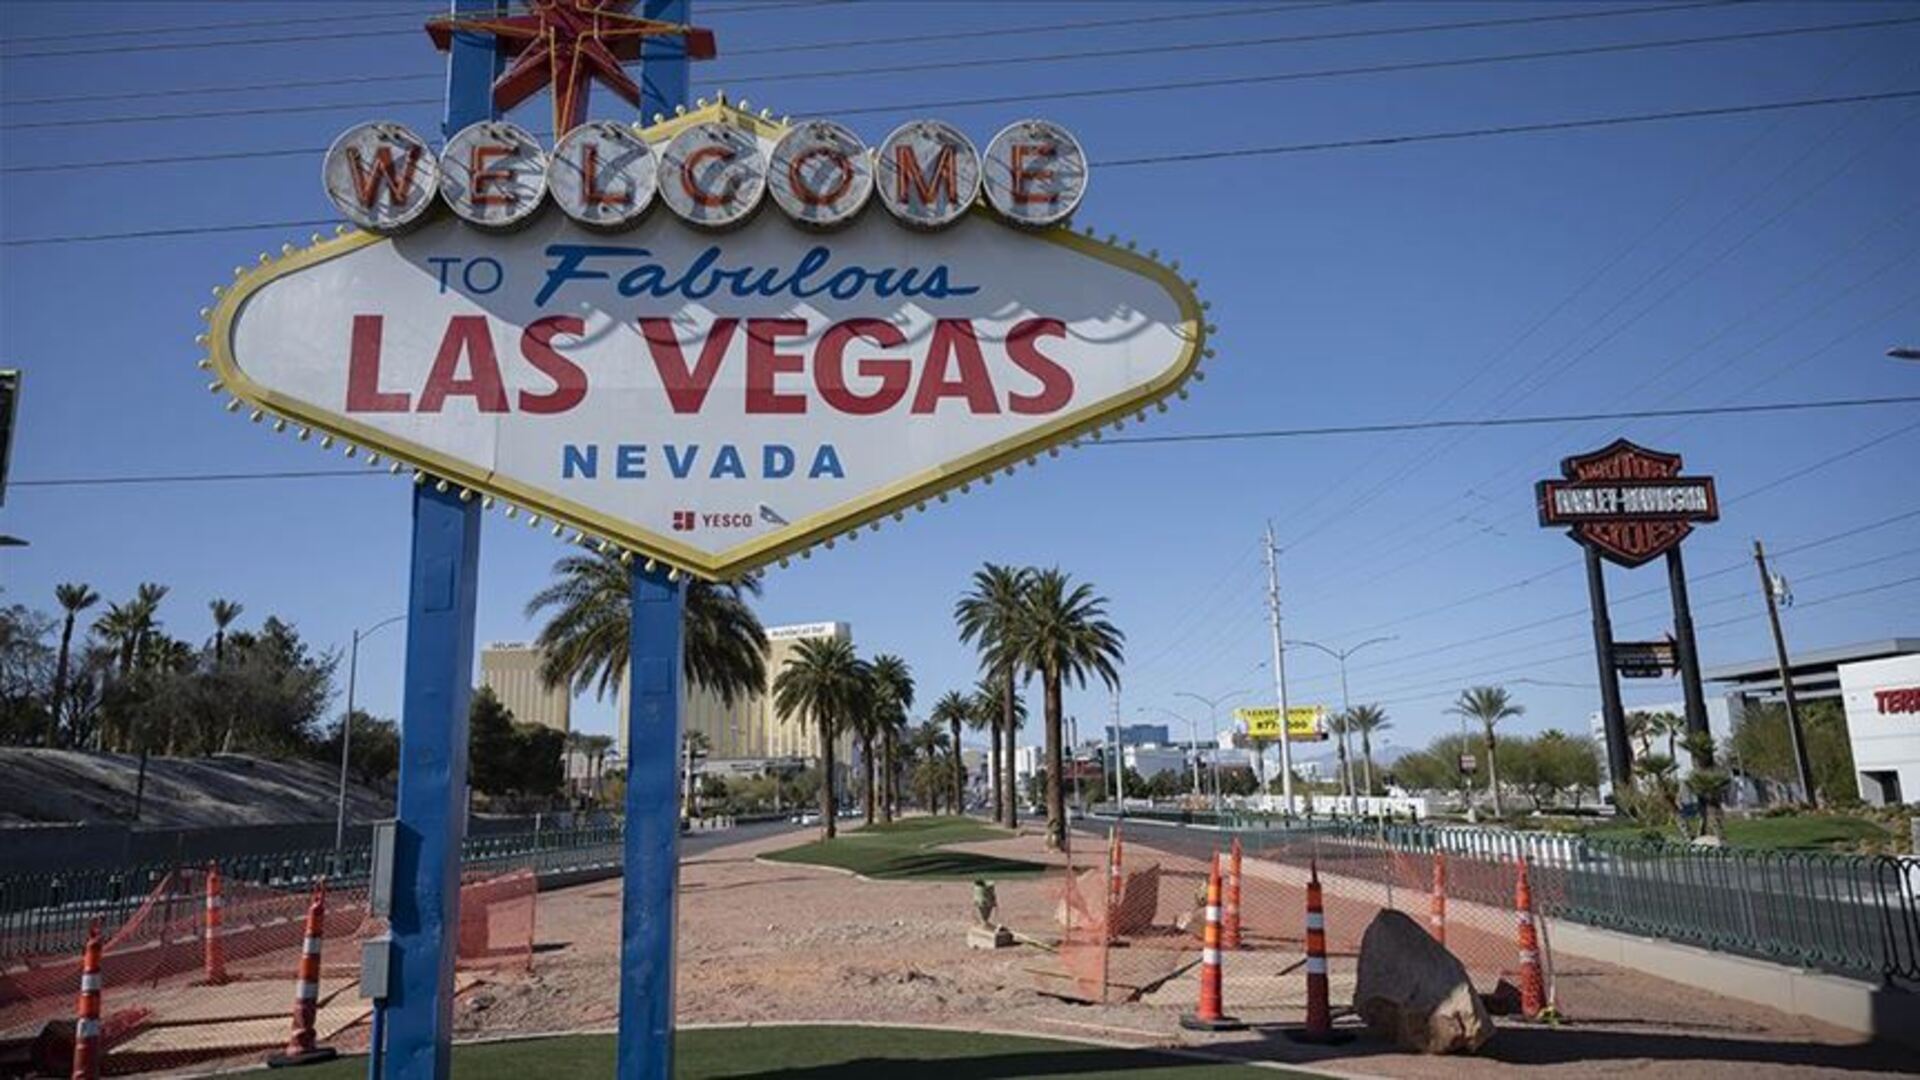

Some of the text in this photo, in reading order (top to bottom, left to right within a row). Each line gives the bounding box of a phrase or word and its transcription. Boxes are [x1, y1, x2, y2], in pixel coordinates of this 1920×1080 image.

[347, 144, 1067, 206] WELCOME
[429, 243, 978, 308] TO Fabulous
[345, 314, 1075, 415] LAS VEGAS
[562, 443, 845, 480] NEVADA
[703, 513, 752, 528] YESCO
[1555, 486, 1708, 514] HARLEY-DAVIDSON
